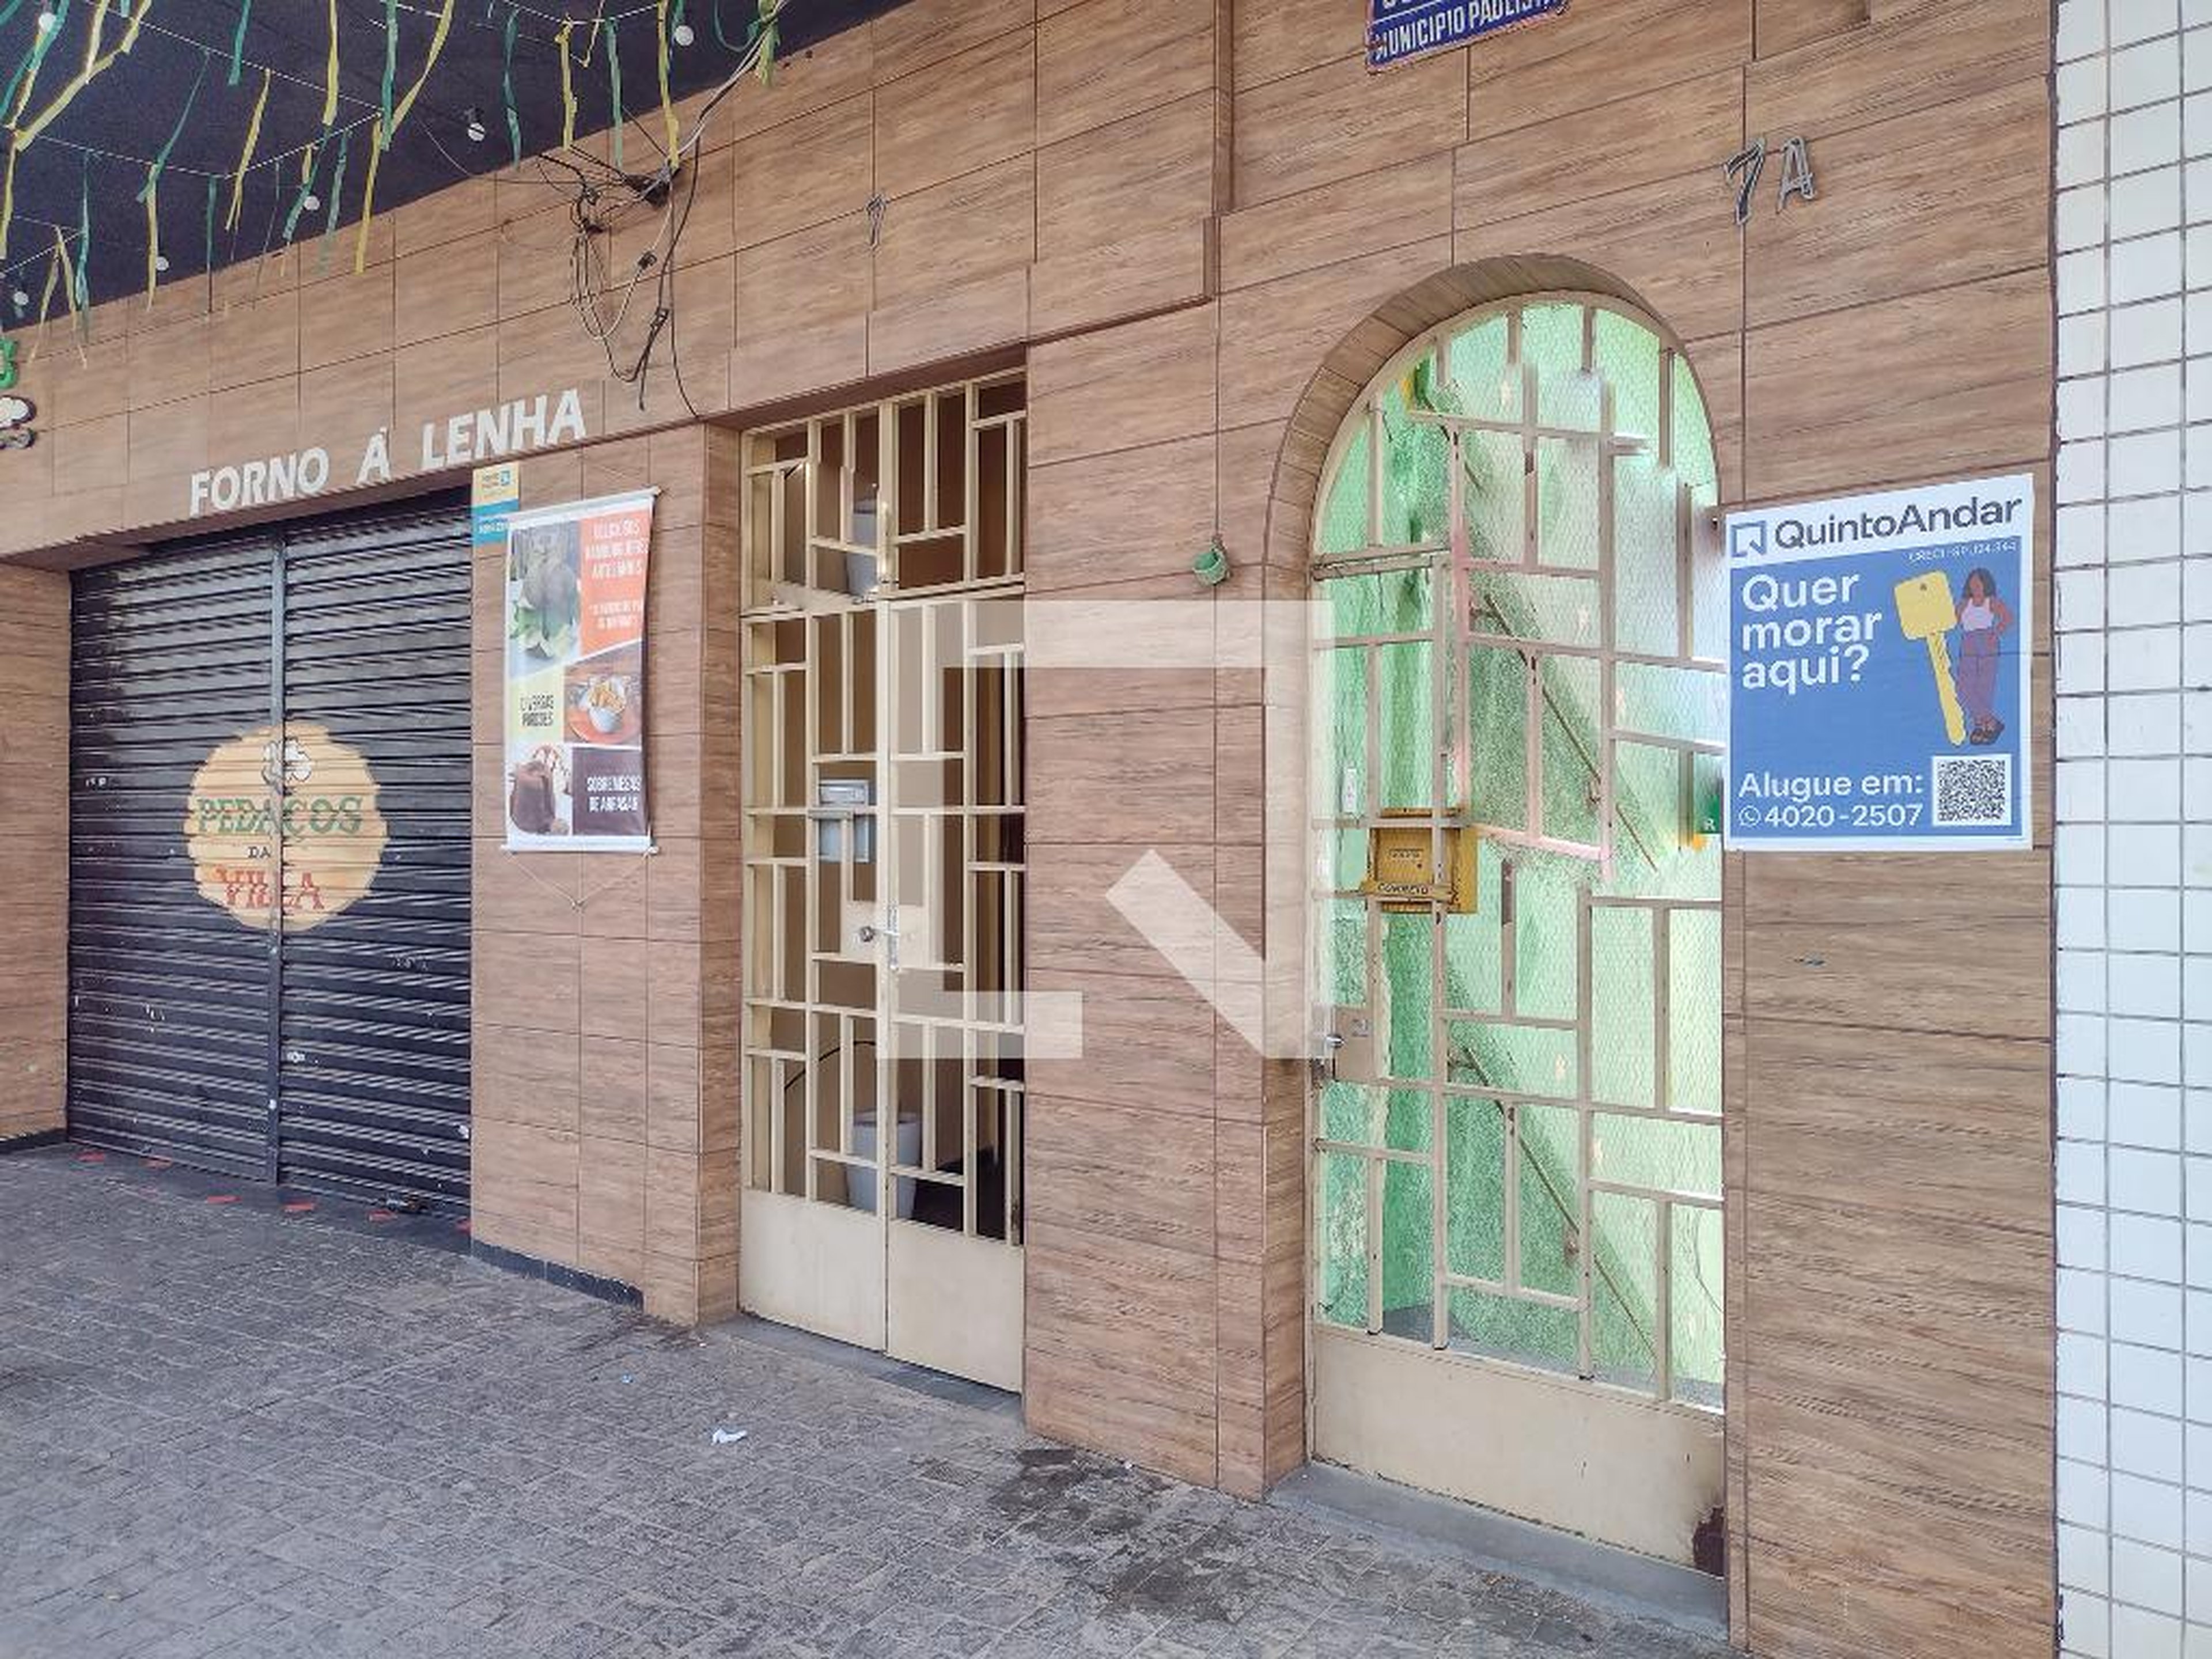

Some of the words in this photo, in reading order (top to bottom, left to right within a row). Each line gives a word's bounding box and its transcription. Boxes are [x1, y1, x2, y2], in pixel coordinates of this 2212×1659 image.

[190, 447, 331, 518] FORNO
[422, 389, 586, 471] LENHA
[1775, 497, 2022, 550] QuintoAndar
[1742, 574, 1859, 612] Quer
[1742, 612, 1883, 652] morar
[1742, 645, 1870, 695] aqui?
[1738, 772, 1853, 801] Alugue
[1861, 773, 1923, 795] em:
